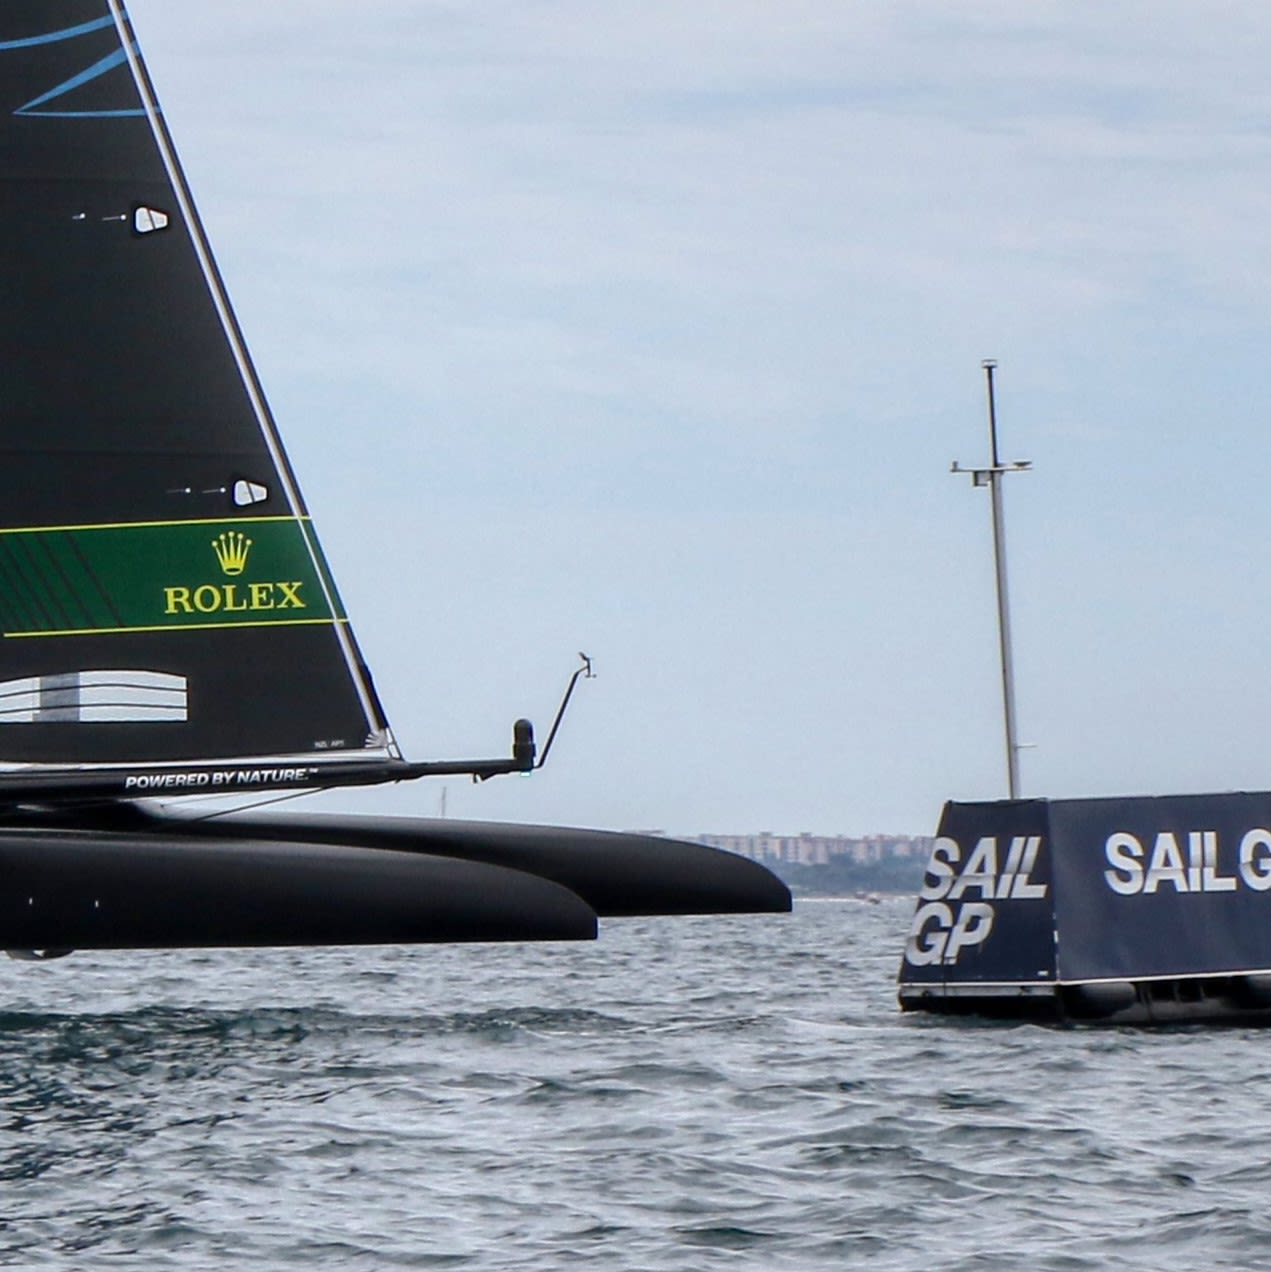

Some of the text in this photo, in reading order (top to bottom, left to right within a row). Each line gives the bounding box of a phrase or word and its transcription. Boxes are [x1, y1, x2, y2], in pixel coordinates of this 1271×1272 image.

[165, 582, 305, 614] ROLEX
[125, 774, 208, 789] POWERED
[212, 772, 235, 784] BY
[919, 836, 1048, 901] SAIL
[904, 901, 995, 966] GP
